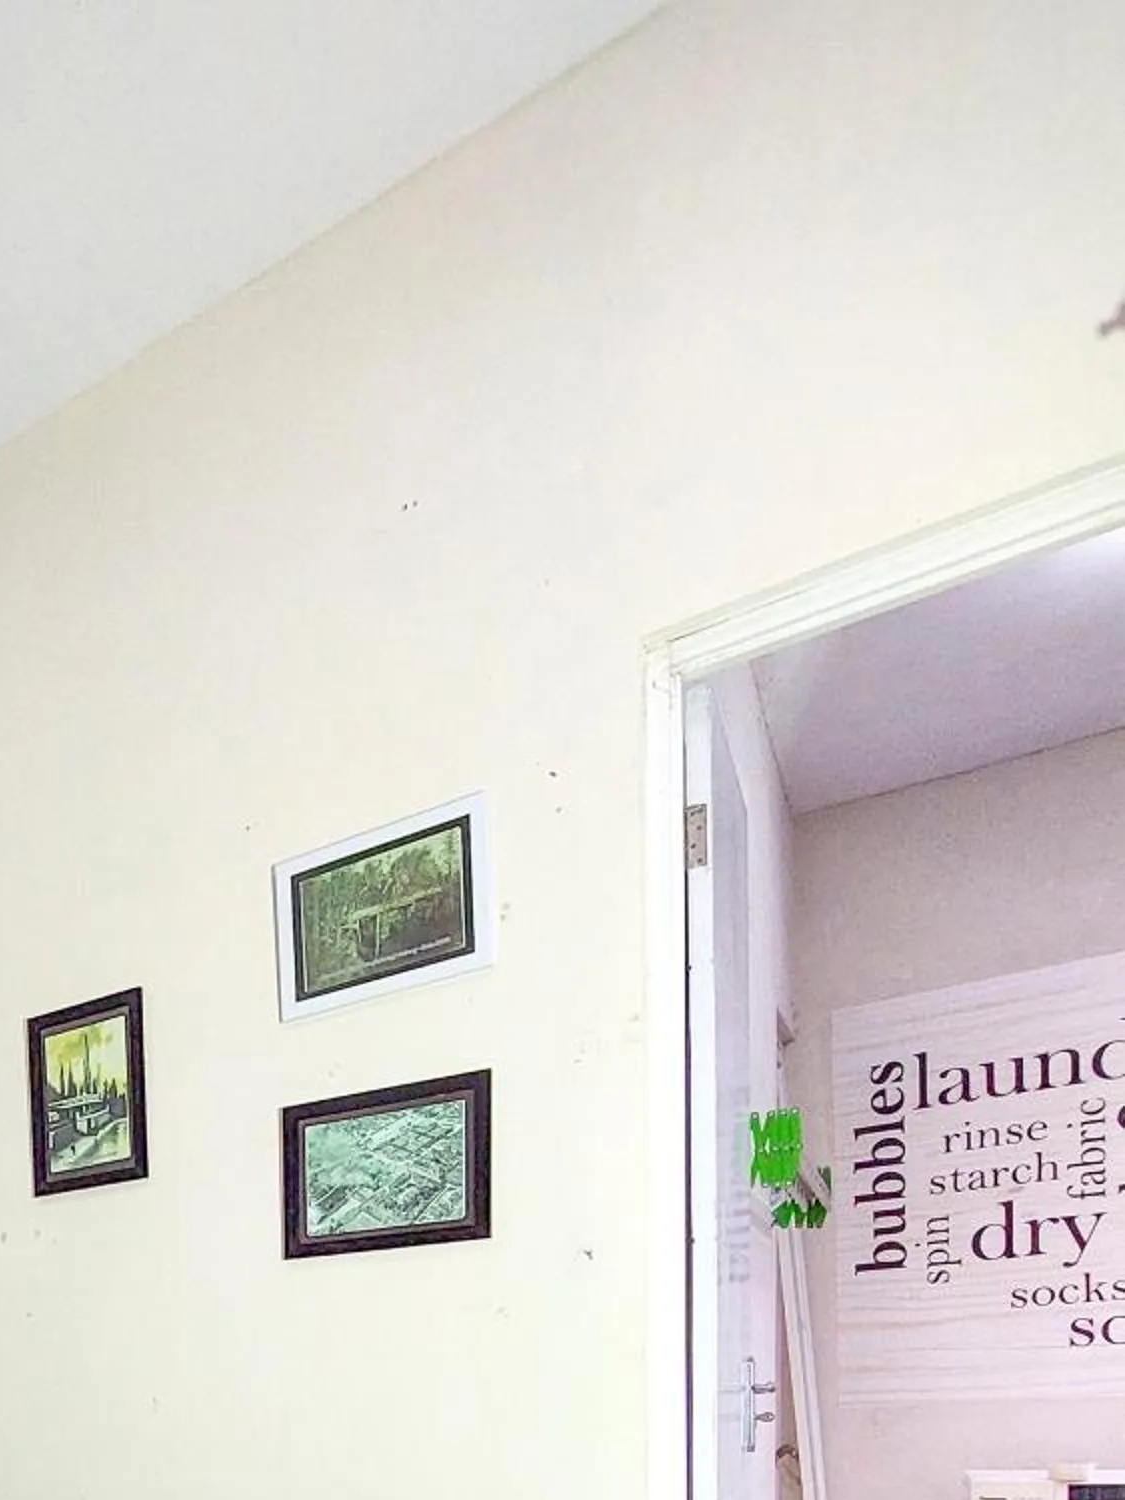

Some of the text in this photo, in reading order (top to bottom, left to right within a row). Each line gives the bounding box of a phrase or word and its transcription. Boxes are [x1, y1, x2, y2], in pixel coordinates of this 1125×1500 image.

[853, 1060, 907, 1275] bubbles
[942, 1120, 1049, 1153] rinse
[1066, 1097, 1106, 1200] fabric
[929, 1152, 1059, 1195] starch
[915, 1215, 962, 1284] spin
[971, 1200, 1107, 1268] dry
